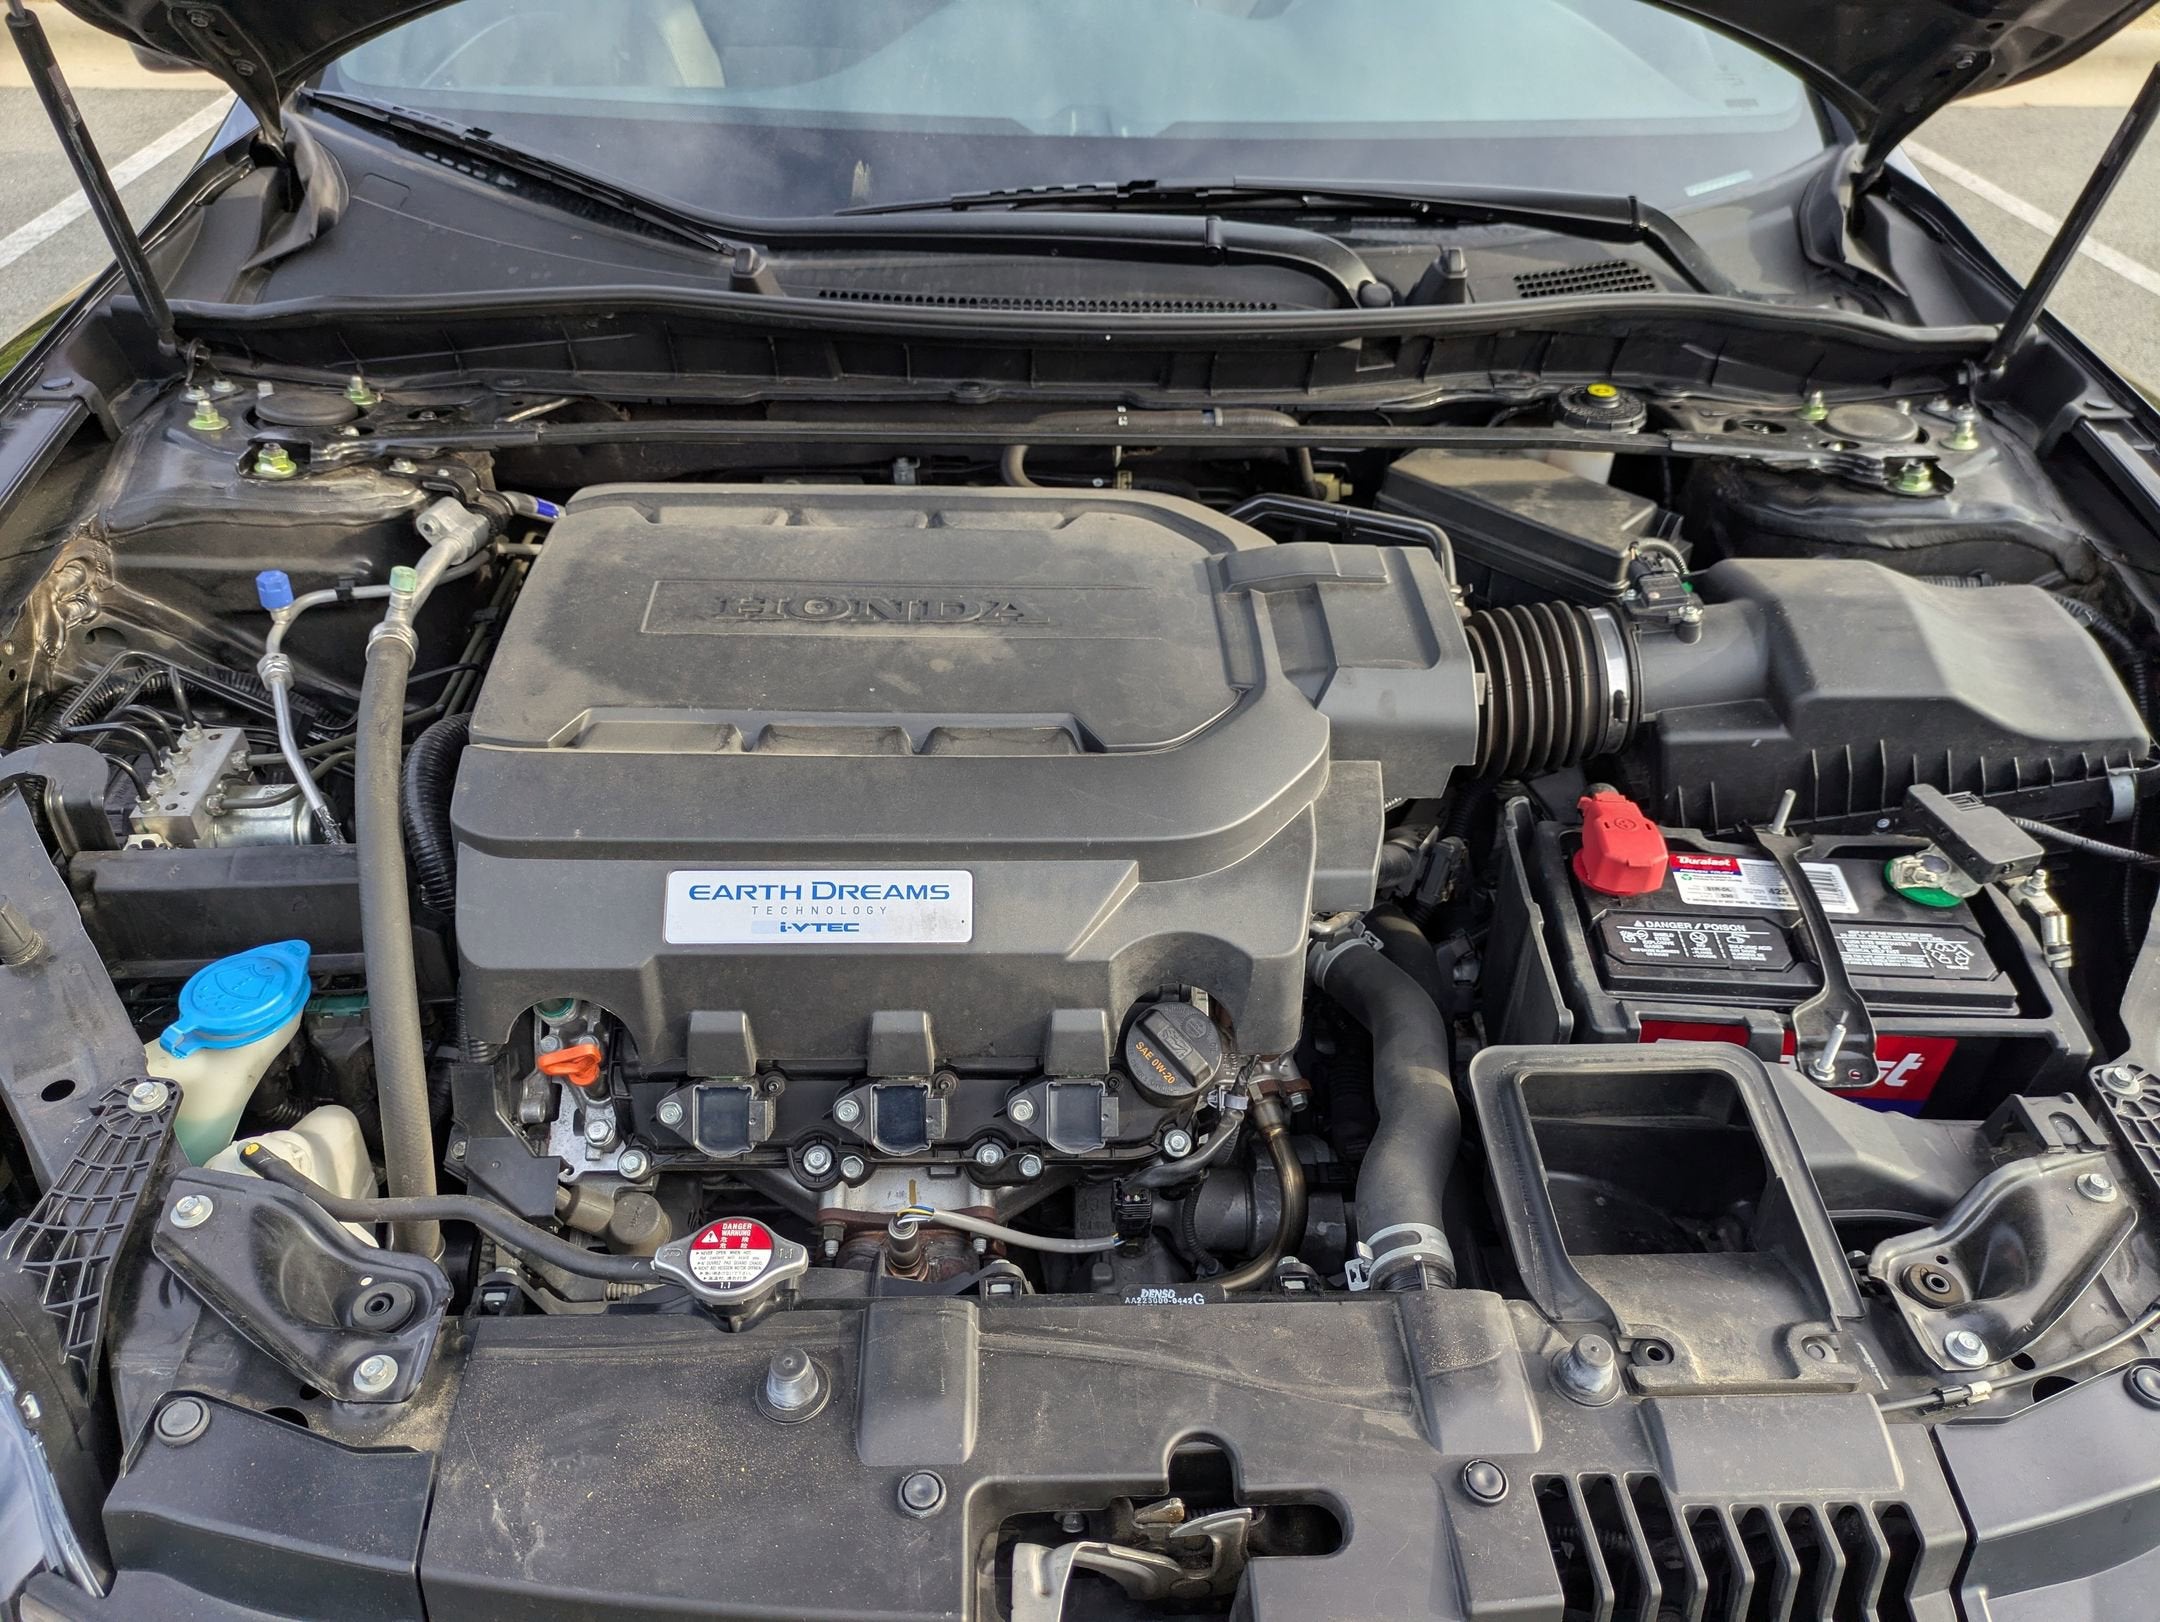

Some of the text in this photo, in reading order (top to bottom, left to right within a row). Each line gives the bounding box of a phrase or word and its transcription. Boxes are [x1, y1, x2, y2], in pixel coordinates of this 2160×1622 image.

[713, 596, 1050, 625] HONDA
[1677, 855, 1731, 867] Duralast
[689, 881, 951, 901] EARTH DREAMS
[1768, 887, 1790, 896] 425
[752, 905, 887, 915] TECHNOLOGY
[780, 921, 859, 932] i-VTEC
[1645, 921, 1693, 930] DANGER
[1704, 923, 1747, 932] POISON
[1135, 1041, 1177, 1084] SAE 0W-20
[720, 1281, 731, 1289] 1.1
[1140, 1288, 1176, 1298] DENSO
